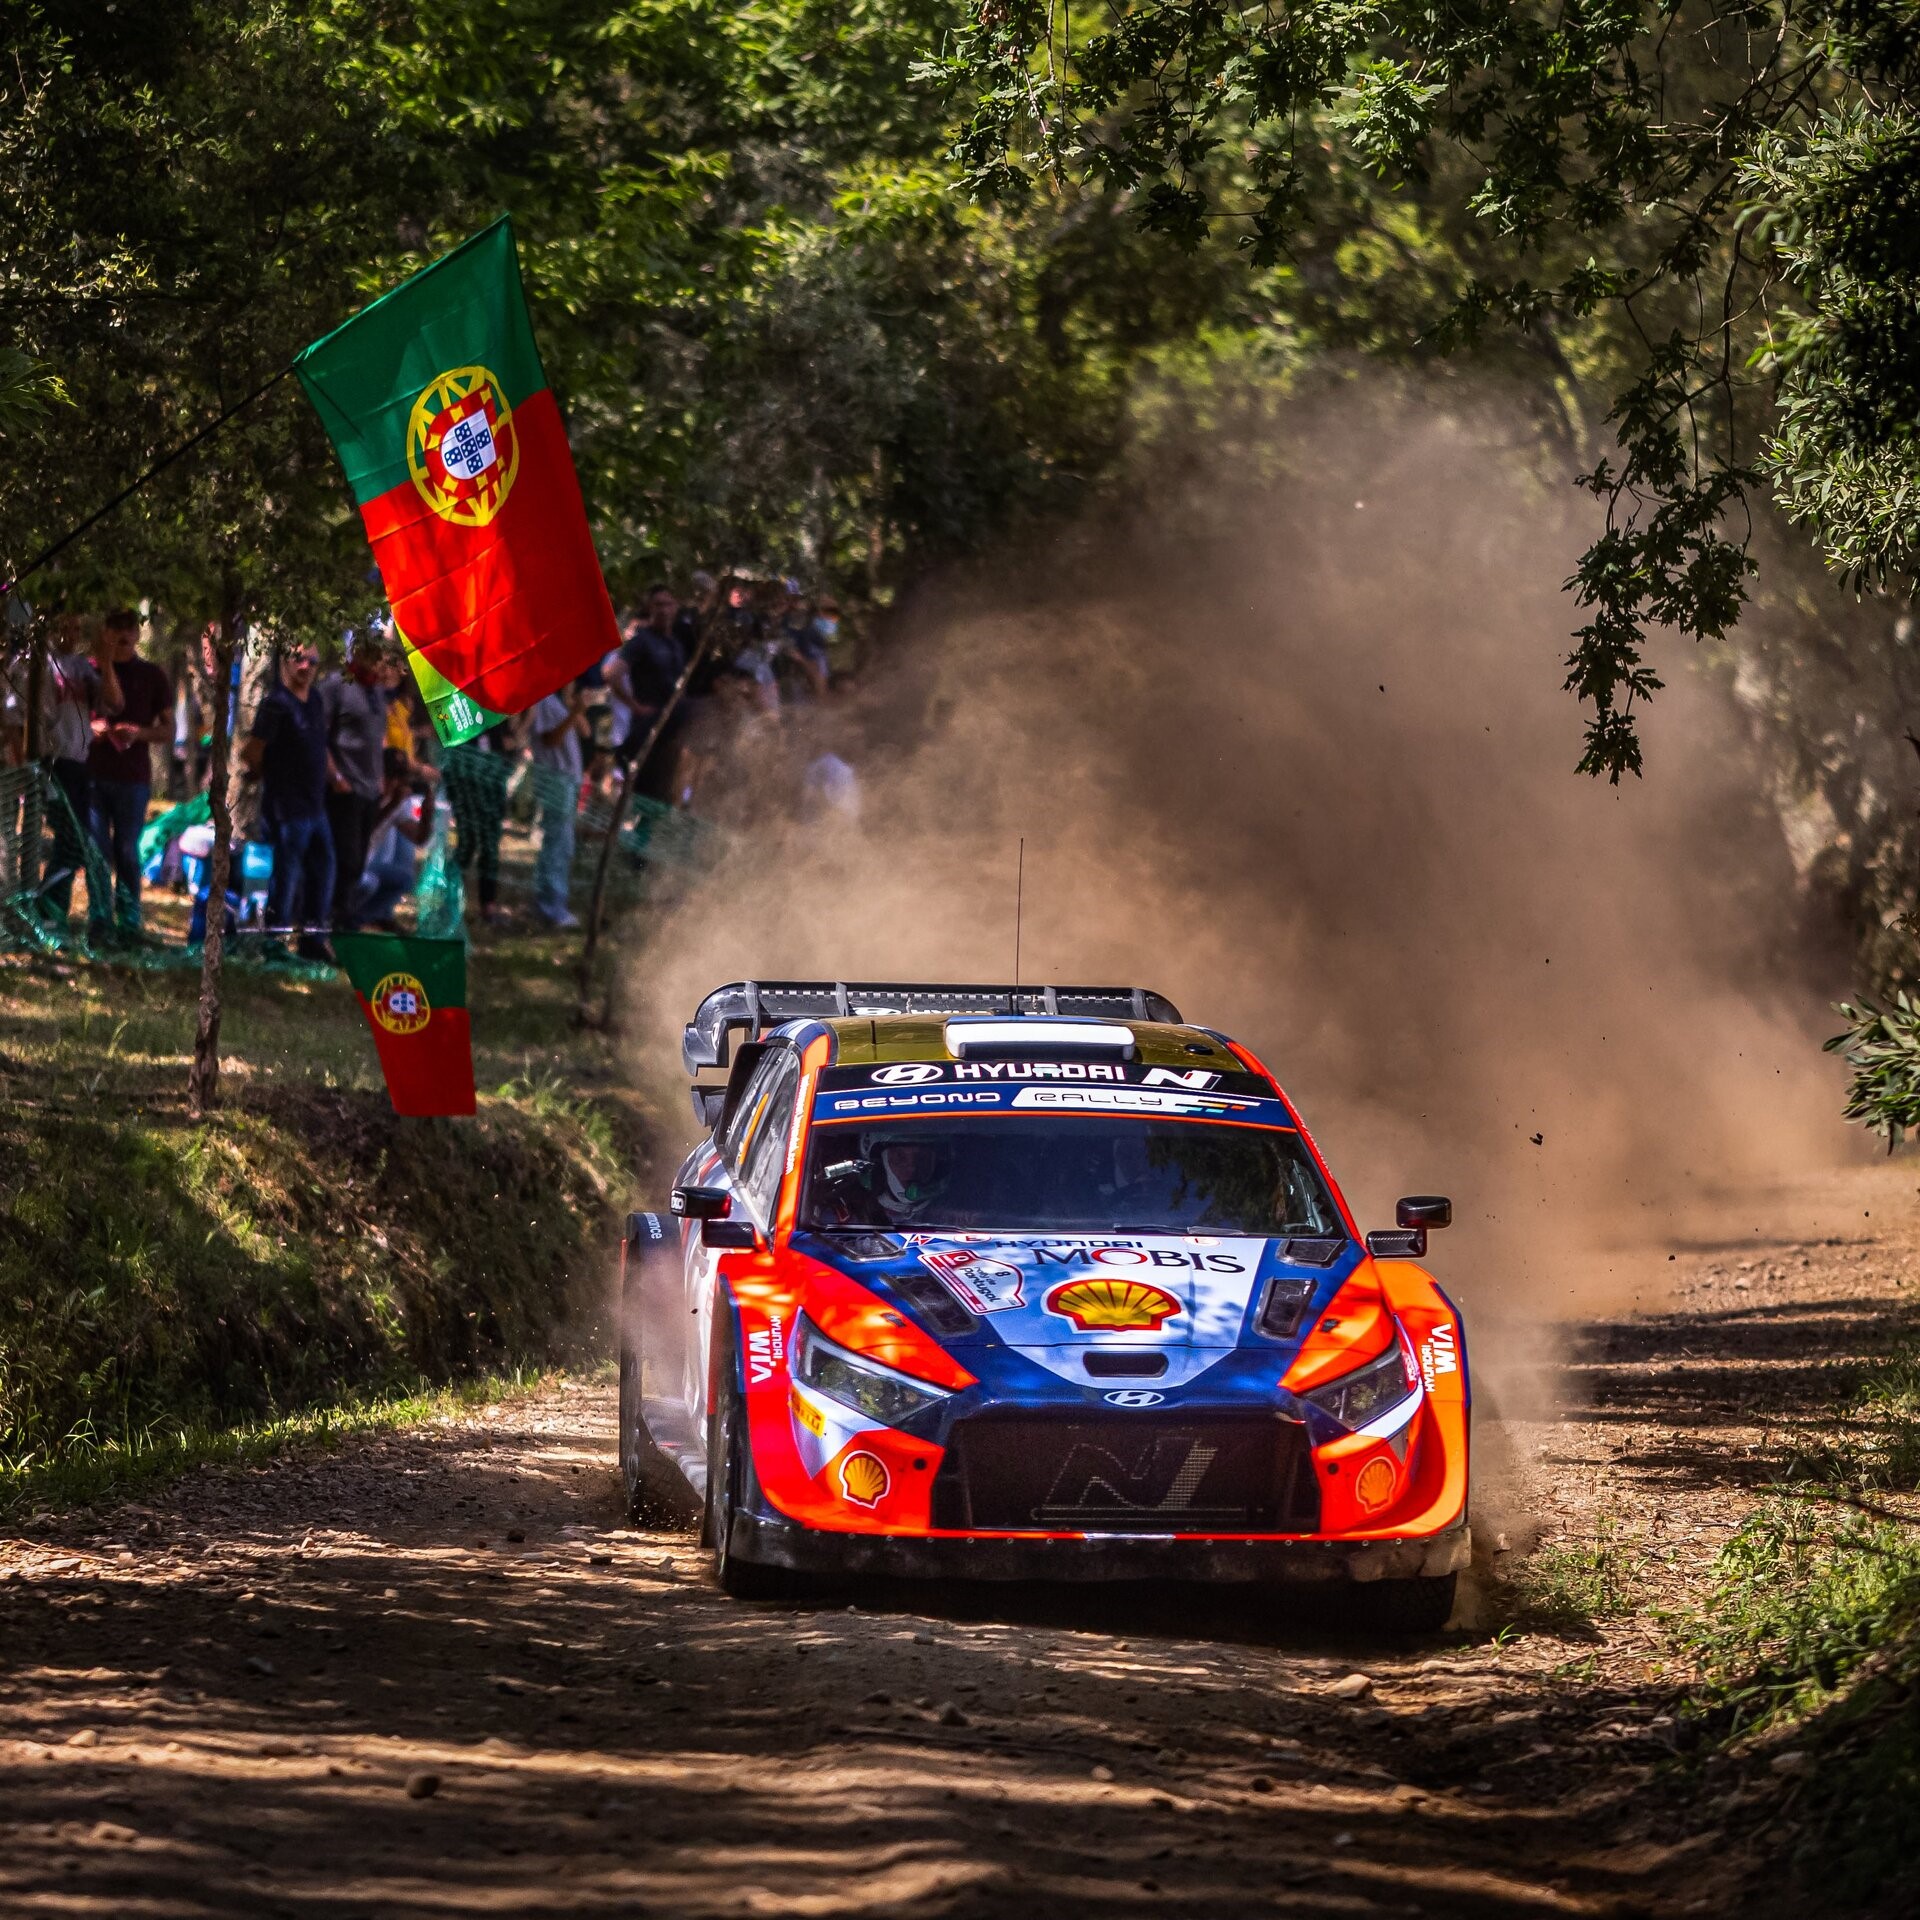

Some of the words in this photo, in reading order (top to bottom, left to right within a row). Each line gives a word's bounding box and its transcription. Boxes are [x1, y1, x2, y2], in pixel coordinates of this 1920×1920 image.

[955, 1063, 1125, 1081] HYUNDAI
[834, 1091, 1000, 1111] BEYOND
[1034, 1092, 1162, 1106] RALLY
[995, 1240, 1144, 1249] HYUNDAI
[1032, 1248, 1246, 1274] MOBIS
[960, 1267, 1002, 1303] Portugal
[770, 1315, 783, 1360] HYUNDAI
[1428, 1323, 1457, 1374] WIA
[749, 1330, 776, 1384] WIA
[1421, 1344, 1435, 1393] HYUNDAI
